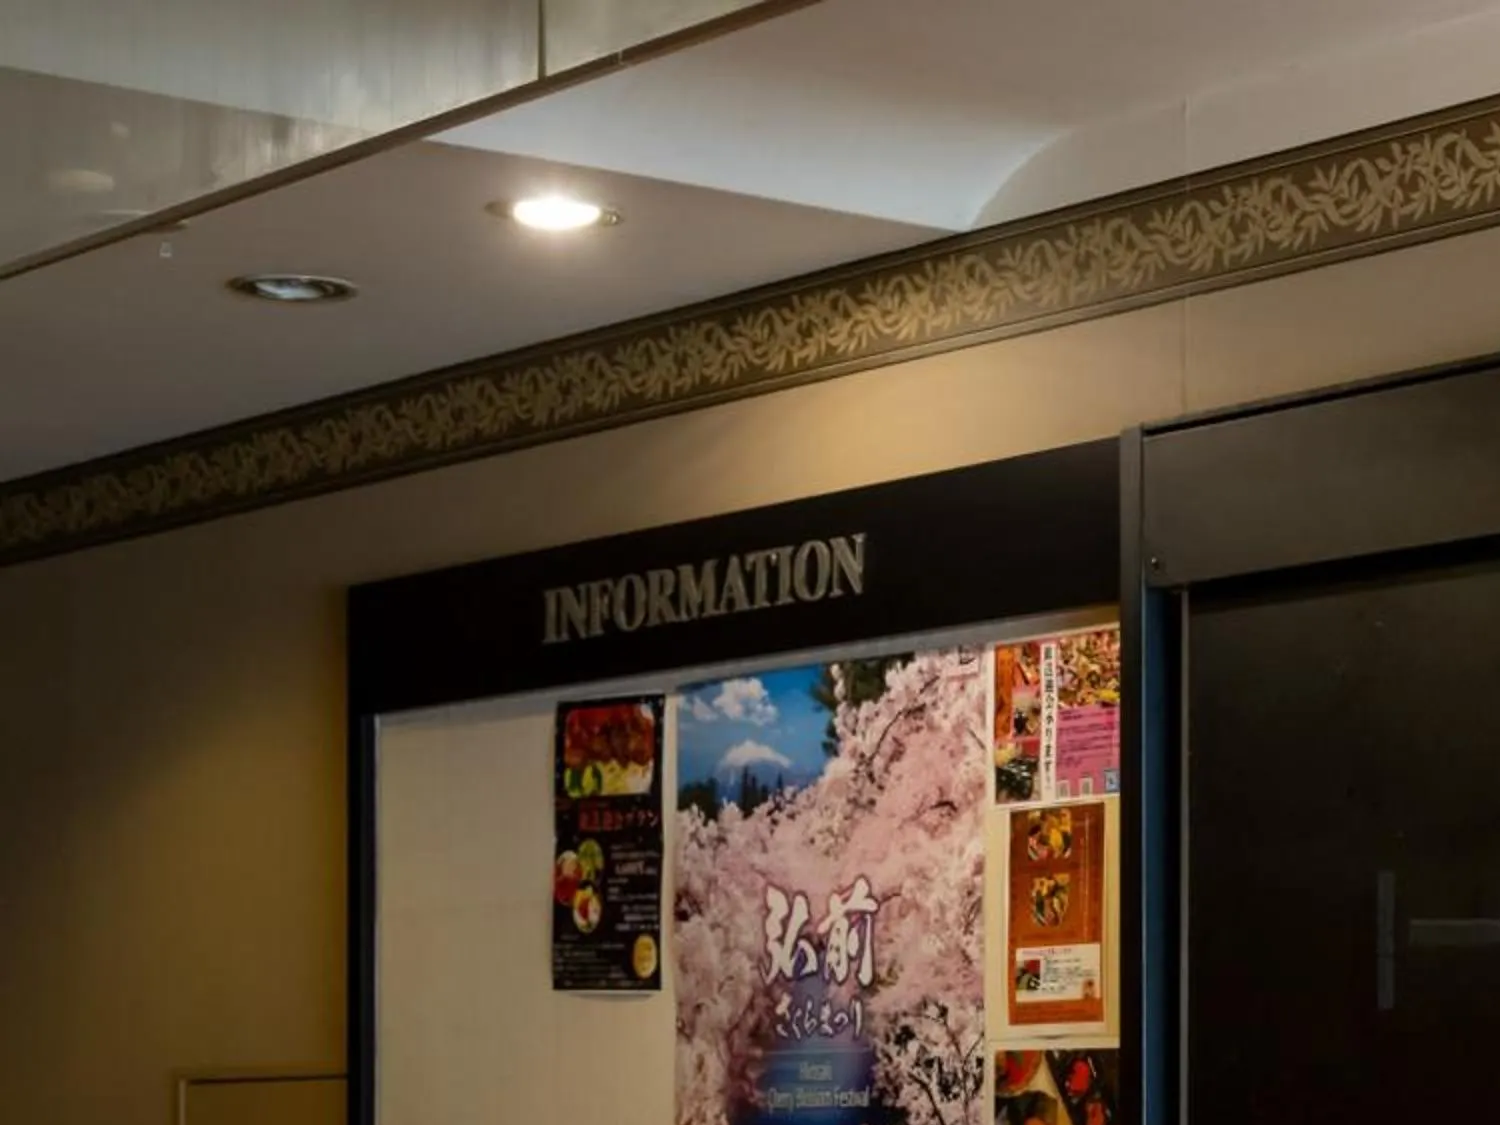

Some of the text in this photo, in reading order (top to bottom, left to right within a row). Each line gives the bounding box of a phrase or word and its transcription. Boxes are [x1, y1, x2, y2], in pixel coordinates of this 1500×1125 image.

[542, 532, 867, 644] INFORMATION
[762, 875, 881, 987] 弘前
[775, 992, 863, 1040] さくらまつり
